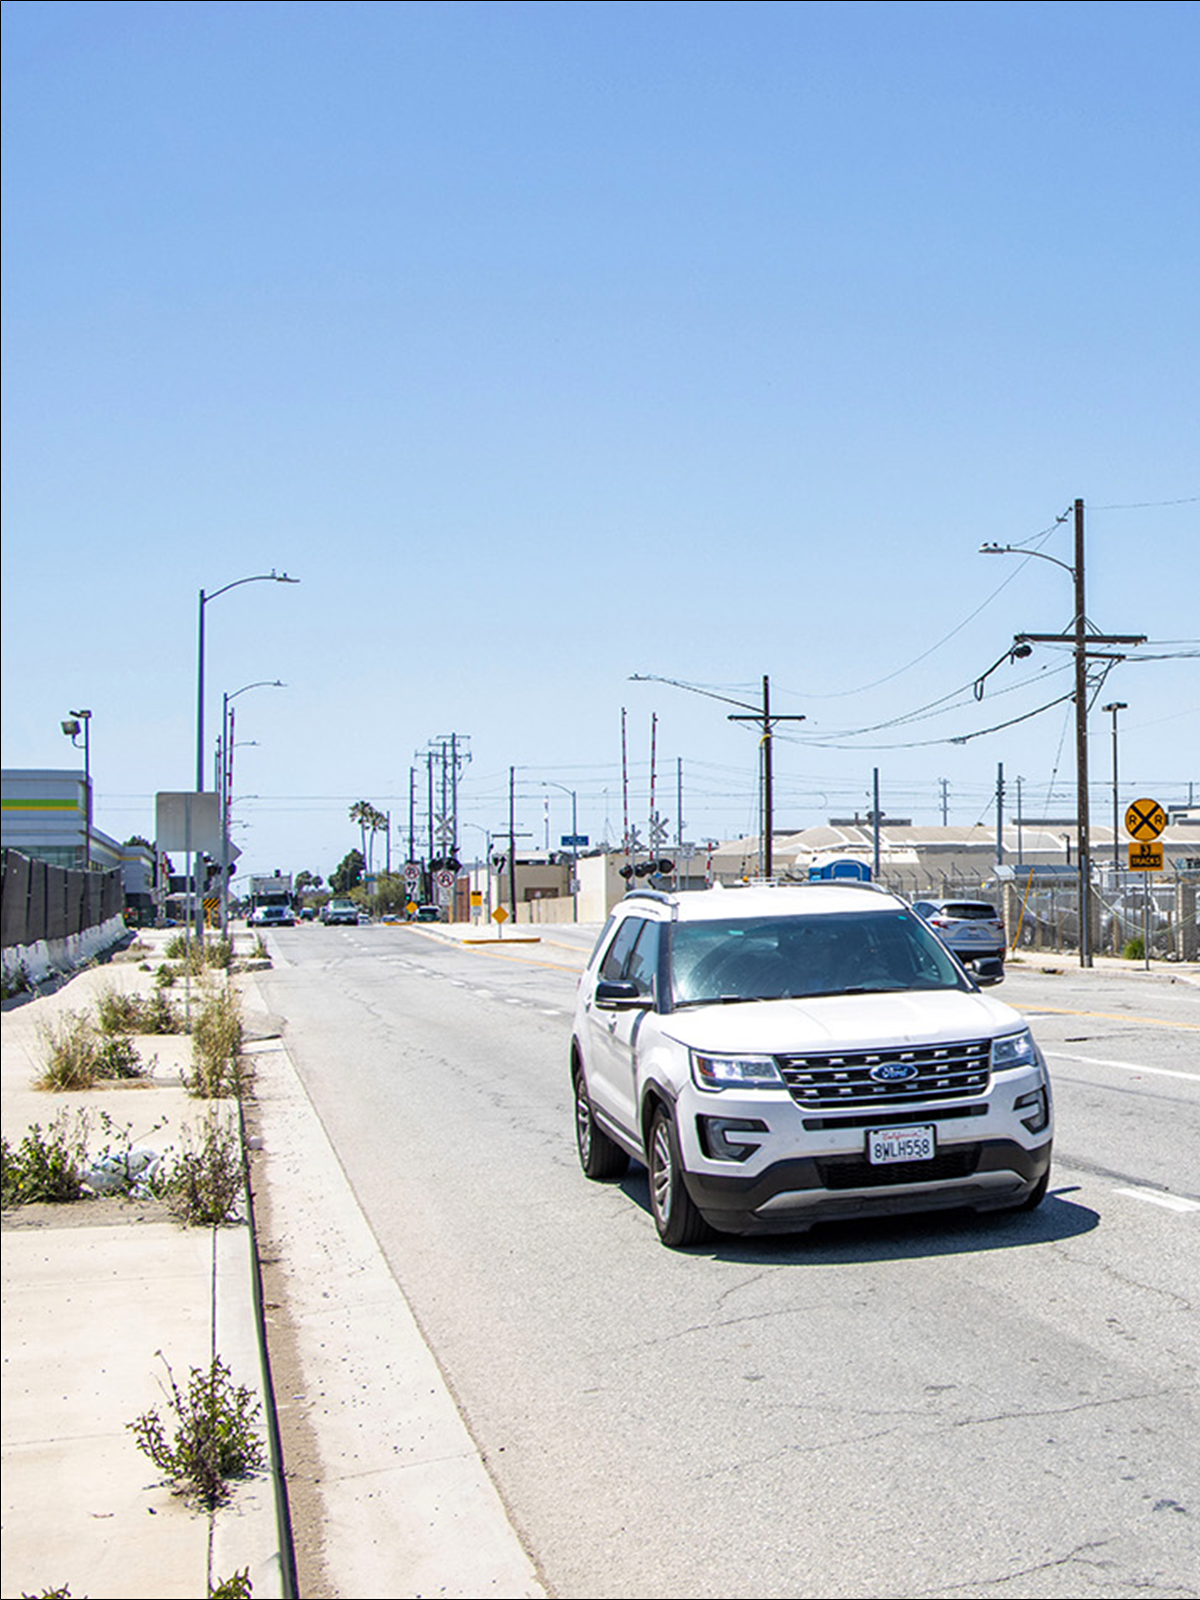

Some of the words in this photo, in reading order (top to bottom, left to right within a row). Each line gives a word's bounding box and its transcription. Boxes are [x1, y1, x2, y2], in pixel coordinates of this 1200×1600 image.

[1129, 814, 1137, 825] R
[1155, 814, 1163, 825] R
[1131, 856, 1161, 867] TRACKS
[882, 1132, 919, 1140] California
[874, 1138, 930, 1160] 8WLH558
